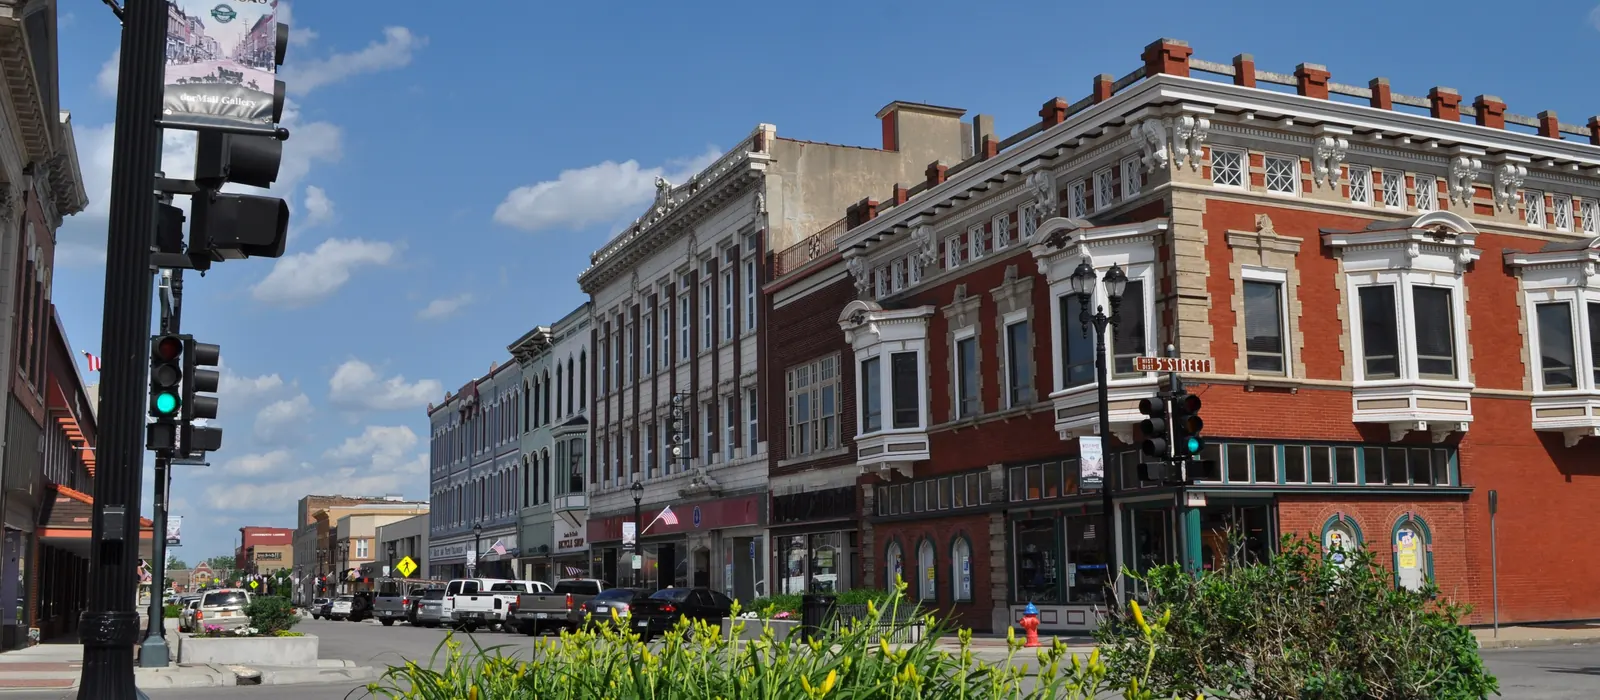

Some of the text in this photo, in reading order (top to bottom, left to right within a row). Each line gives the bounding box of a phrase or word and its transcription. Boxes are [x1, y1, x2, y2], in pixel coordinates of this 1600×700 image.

[221, 96, 256, 108] Gallery
[1167, 359, 1206, 372] STREET
[573, 538, 584, 548] SHOP
